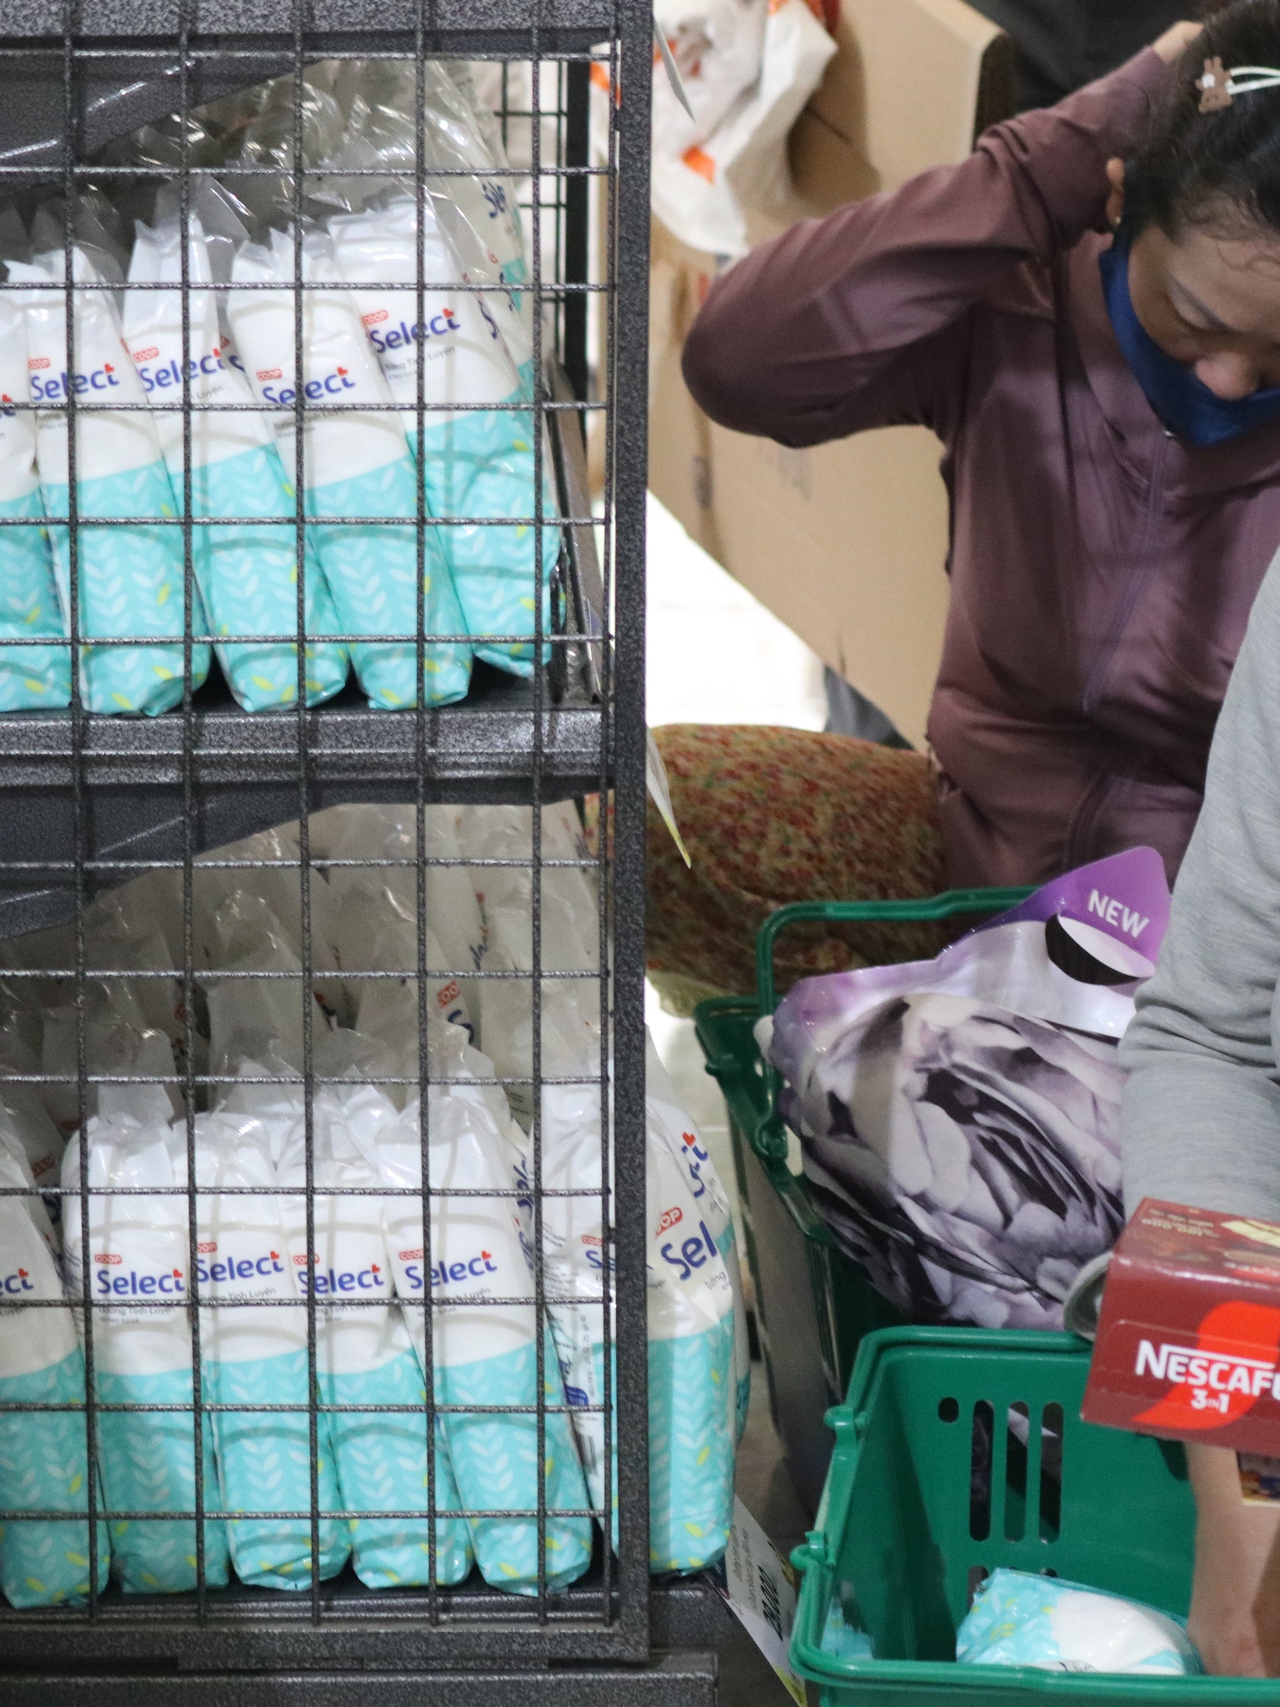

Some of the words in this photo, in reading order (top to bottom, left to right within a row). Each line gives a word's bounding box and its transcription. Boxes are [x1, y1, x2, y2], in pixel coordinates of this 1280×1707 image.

[362, 311, 388, 325] COOP
[370, 308, 461, 354] Select
[30, 363, 120, 402] Select
[139, 347, 226, 392] Select
[262, 366, 356, 404] Seect
[1088, 888, 1150, 938] NEW
[582, 1235, 603, 1247] COO
[661, 1220, 718, 1280] Sel
[97, 1268, 185, 1295] Select
[197, 1251, 284, 1282] Select
[298, 1264, 384, 1294] Select
[405, 1251, 498, 1289] Select
